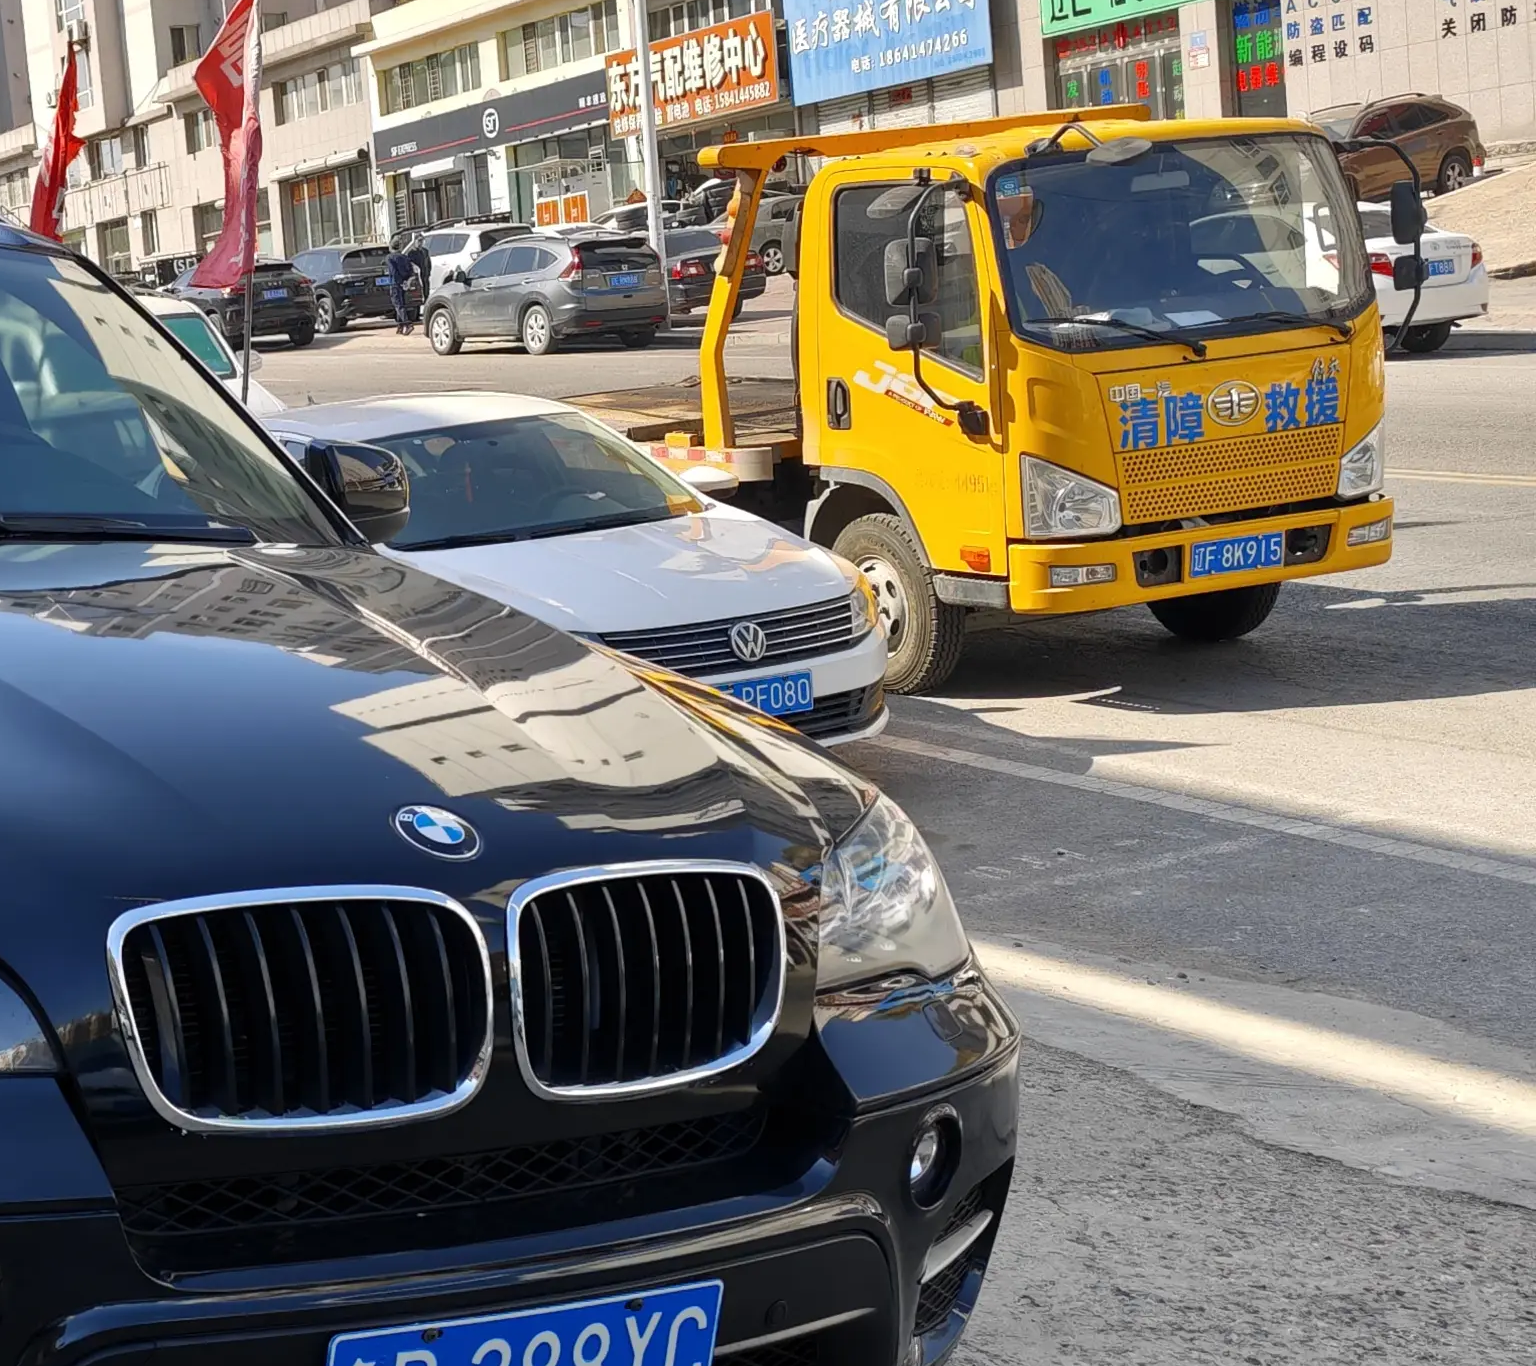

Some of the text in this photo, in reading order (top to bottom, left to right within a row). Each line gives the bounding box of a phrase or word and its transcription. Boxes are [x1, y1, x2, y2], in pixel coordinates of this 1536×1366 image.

[1286, 6, 1374, 41] 防盗匹配
[1441, 5, 1536, 39] 关闭防
[879, 29, 969, 67] 18641474266
[1289, 34, 1375, 67] 编程设码
[1109, 381, 1173, 403] 中国一汽
[1119, 377, 1340, 450] 清障 救援
[726, 678, 810, 710] PF080
